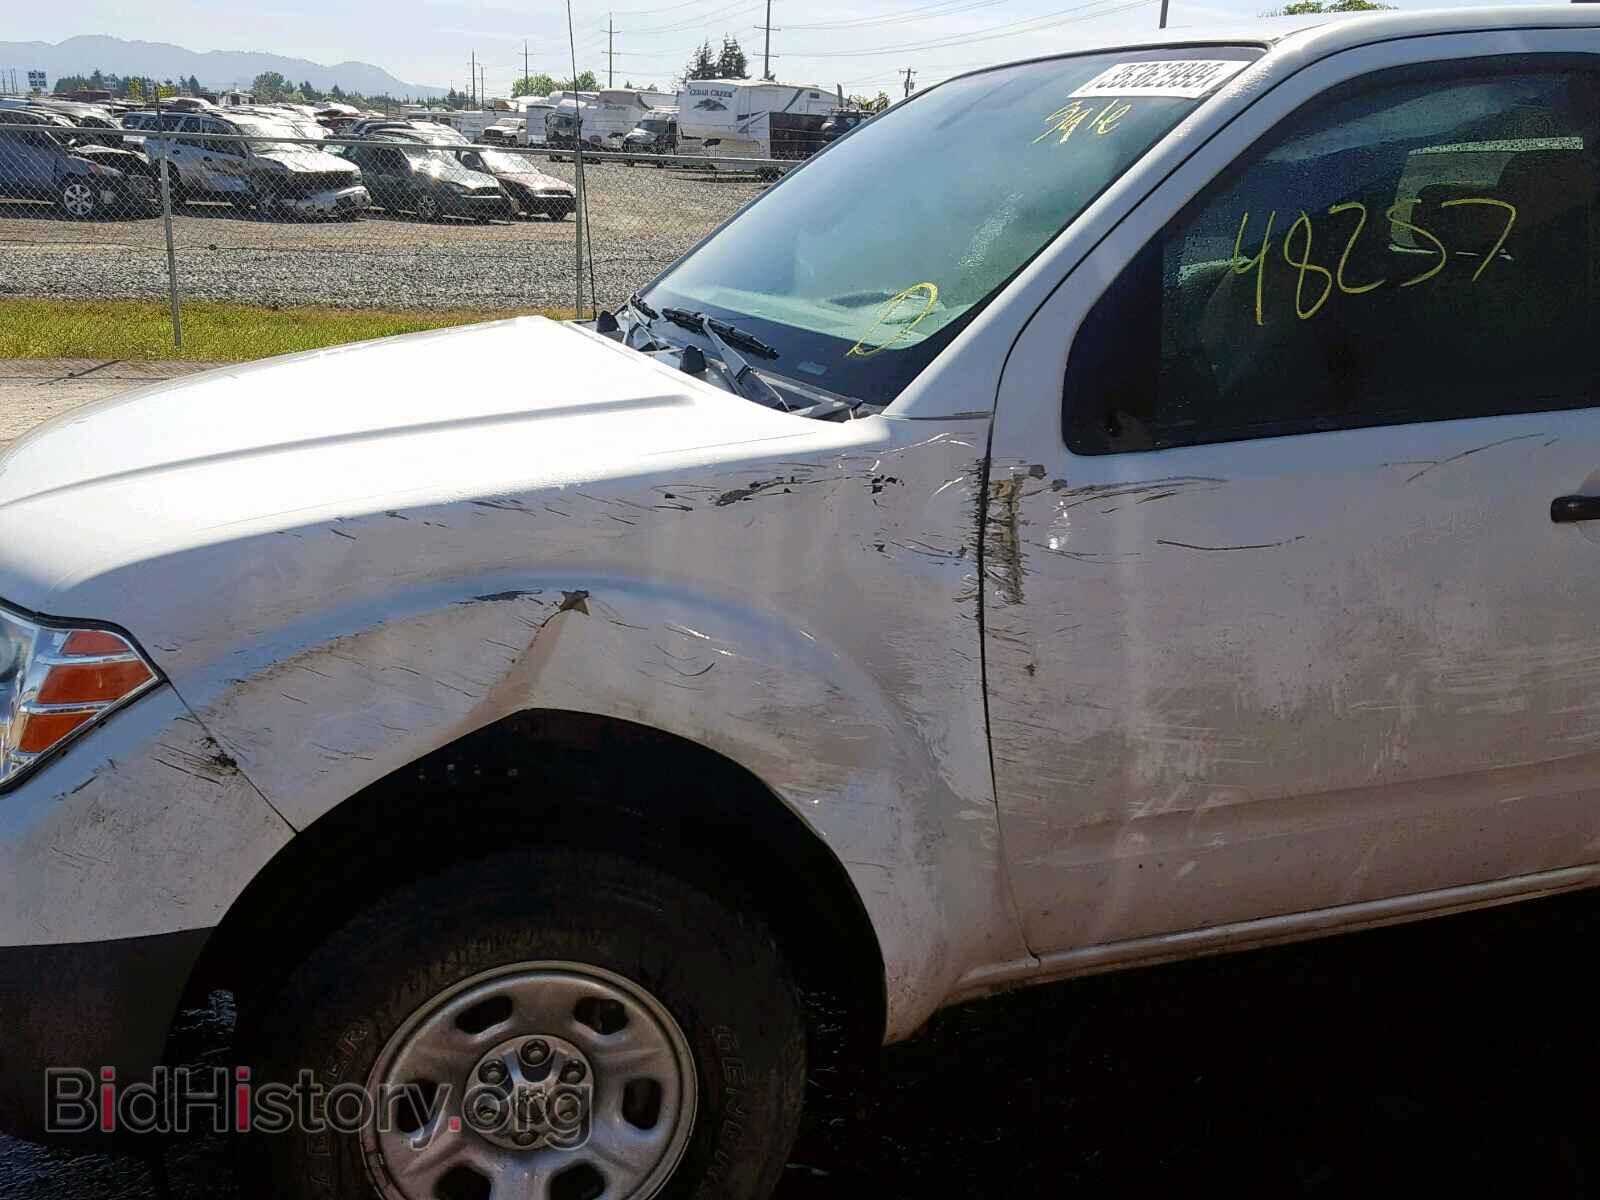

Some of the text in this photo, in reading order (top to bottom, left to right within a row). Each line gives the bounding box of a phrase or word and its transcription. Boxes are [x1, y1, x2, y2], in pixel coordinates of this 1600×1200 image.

[689, 87, 733, 98] CEDAR CREEK
[1232, 197, 1517, 326] 48257
